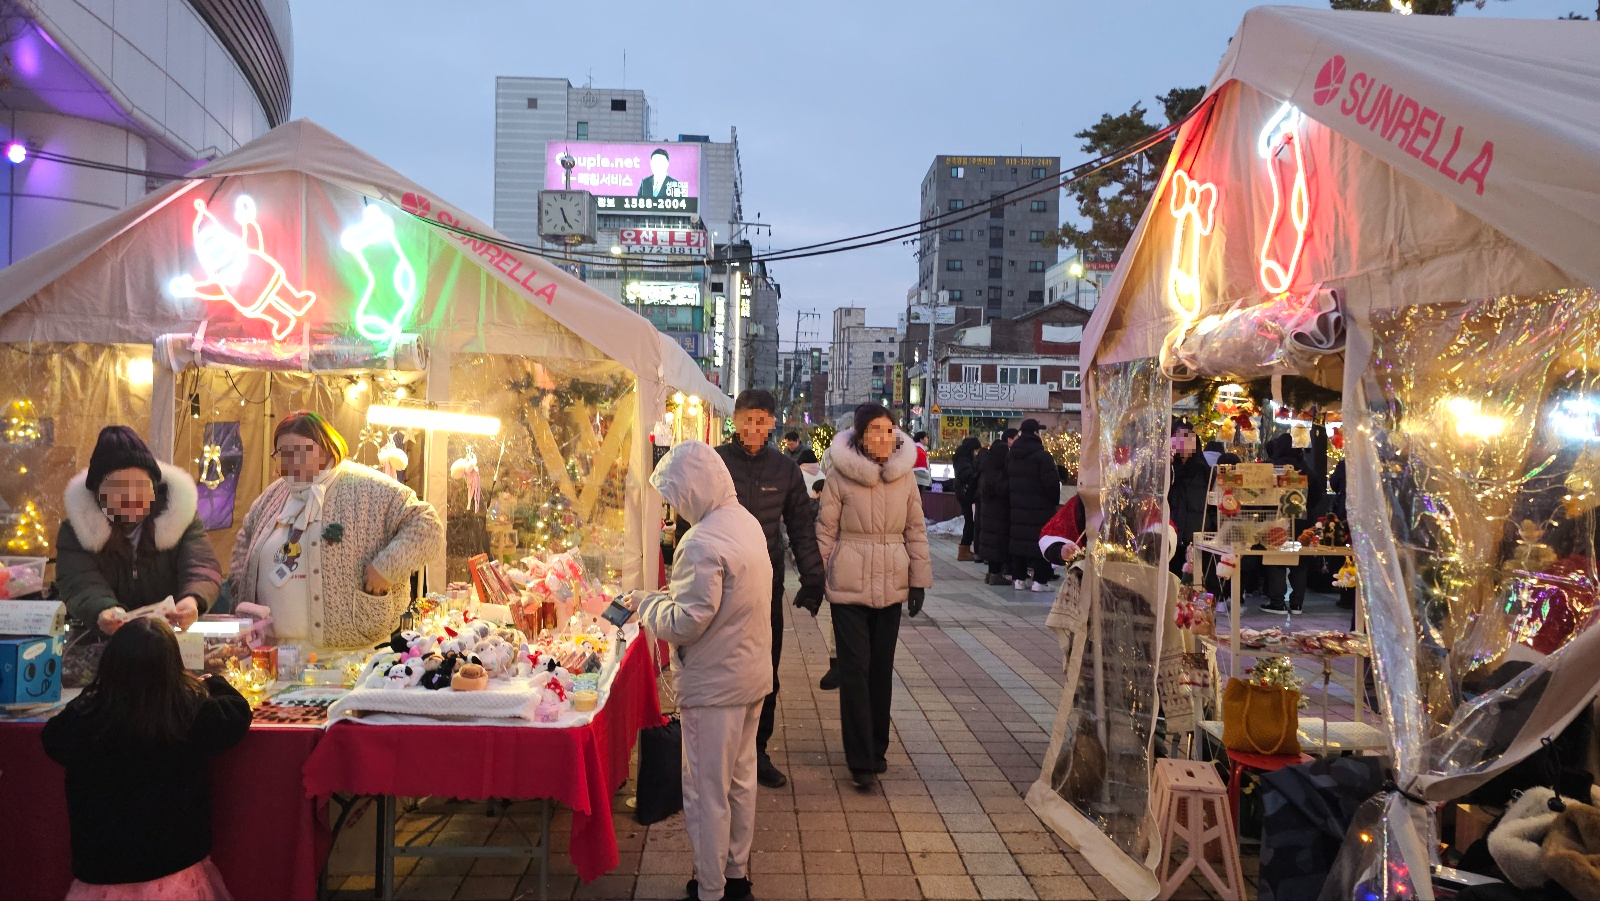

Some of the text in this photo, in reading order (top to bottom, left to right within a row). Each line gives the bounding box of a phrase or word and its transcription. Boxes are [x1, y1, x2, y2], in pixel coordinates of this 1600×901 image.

[1340, 72, 1495, 196] SUNRELLA
[555, 151, 641, 171] Cuple.net
[623, 198, 687, 210] 1588-2004
[621, 230, 705, 248] 오산렌트카
[436, 210, 558, 306] SUNRELLA
[894, 364, 903, 400] 서울부동산
[937, 382, 1017, 402] 명성렌트카
